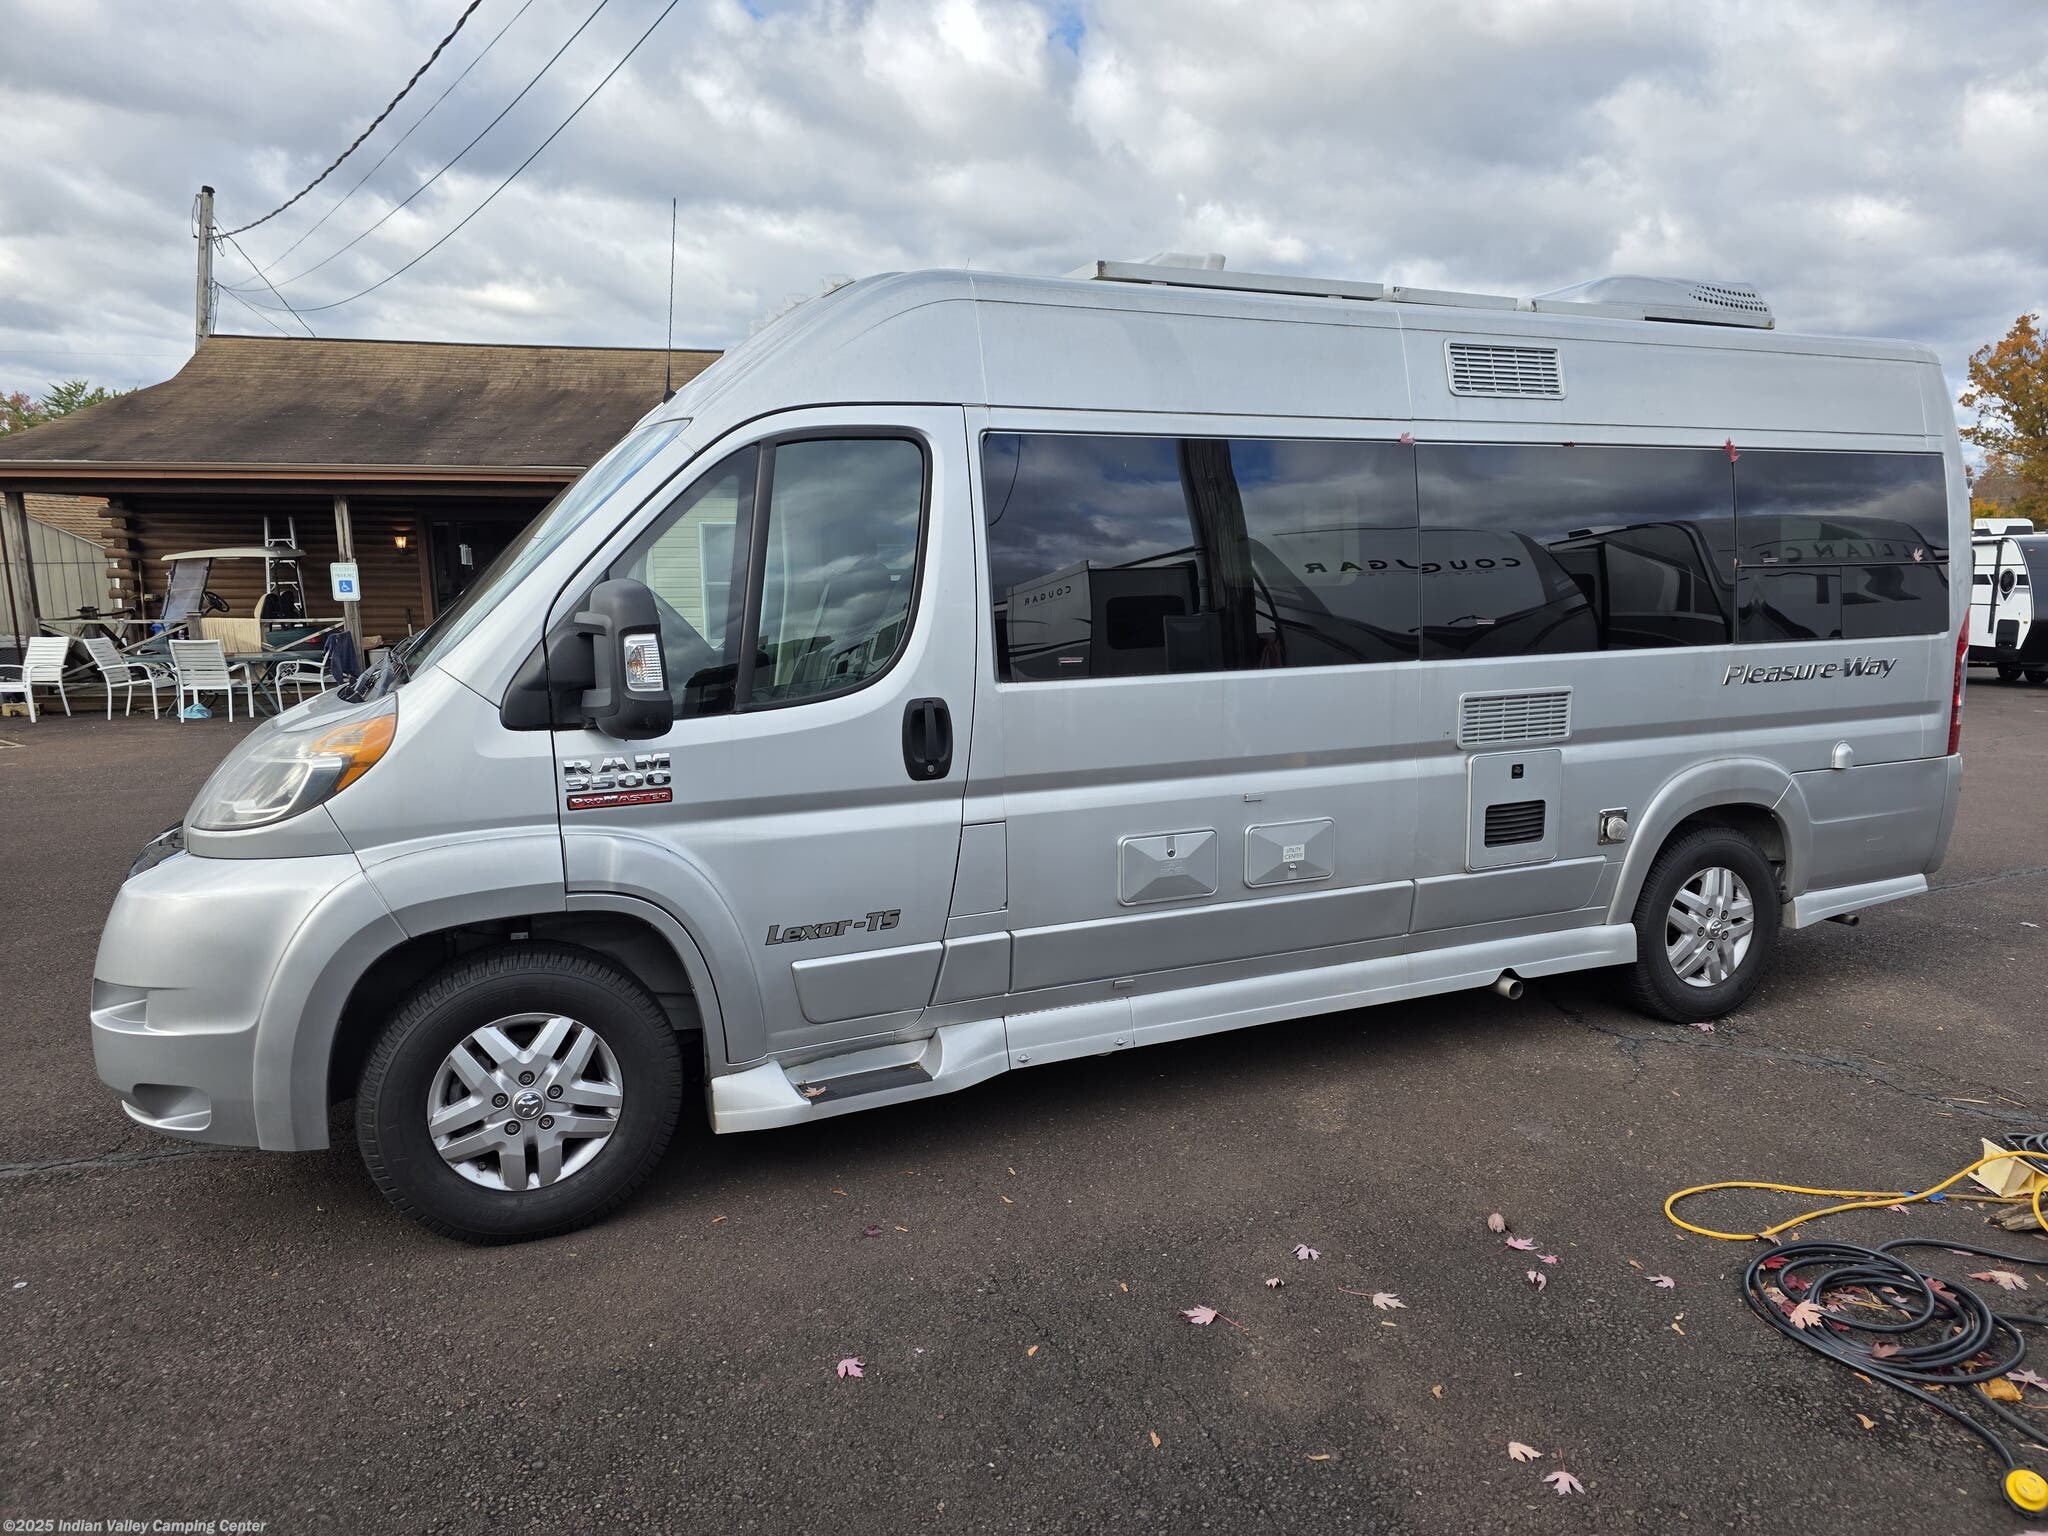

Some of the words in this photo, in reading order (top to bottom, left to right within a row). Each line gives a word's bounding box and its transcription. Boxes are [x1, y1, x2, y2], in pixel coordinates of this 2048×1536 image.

[1721, 656, 1897, 686] Pleasure-Way
[563, 752, 672, 776] RAM
[565, 769, 672, 793] 3500
[765, 909, 901, 946] Lexor-TS
